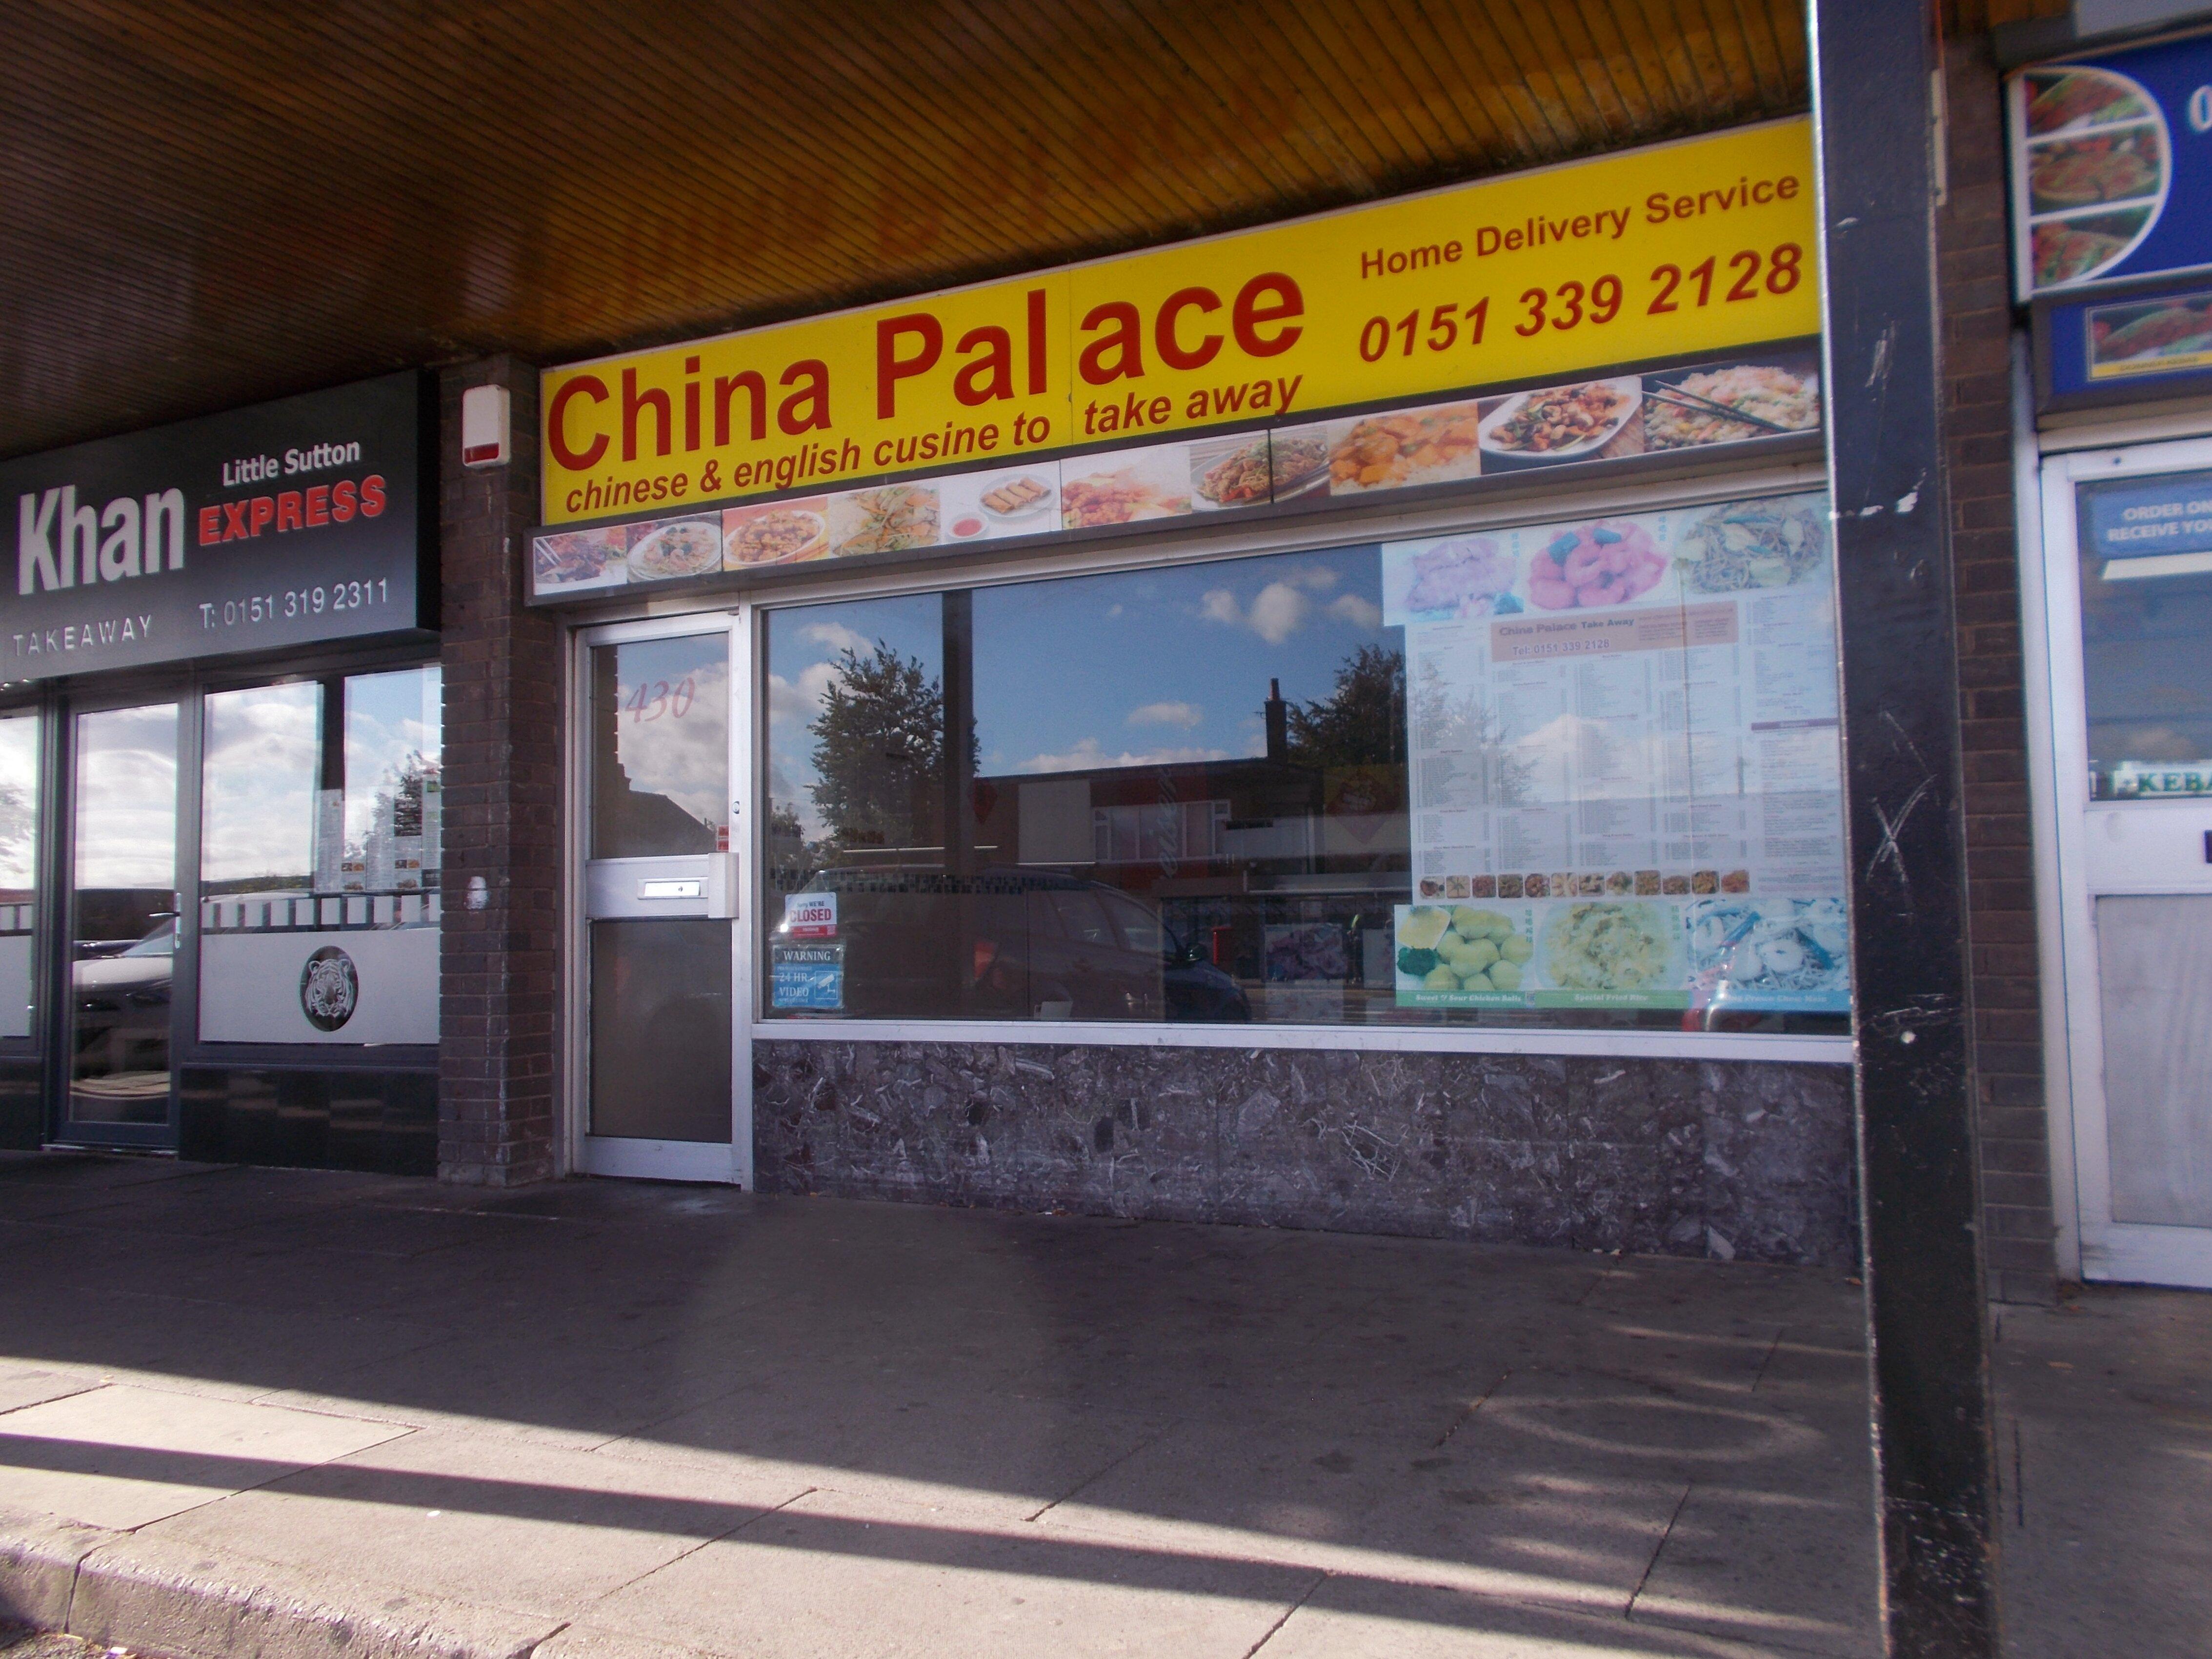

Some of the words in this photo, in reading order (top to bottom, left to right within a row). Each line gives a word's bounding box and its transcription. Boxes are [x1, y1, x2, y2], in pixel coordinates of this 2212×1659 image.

[1361, 241, 1463, 279] Home
[1476, 207, 1631, 257] Delivery
[1646, 176, 1799, 223] Service
[1359, 297, 1490, 363] 0151
[1515, 274, 1624, 337] 339
[1647, 242, 1803, 315] 2128
[547, 355, 833, 471] China
[876, 271, 1305, 420] Palace
[223, 452, 279, 487] Little
[284, 441, 360, 475] Sutton
[566, 472, 689, 513] chinese
[700, 459, 722, 492] &
[733, 438, 860, 489] english
[874, 422, 999, 466] cusine
[1013, 411, 1050, 446] to
[1084, 393, 1171, 435] take
[1186, 374, 1304, 418] away
[199, 475, 387, 546] EXPRESS
[2107, 521, 2180, 542] RECEIVE
[2123, 502, 2184, 521] ORDER
[18, 484, 185, 595] Khan
[200, 603, 216, 629] T:
[224, 596, 273, 627] 0151
[284, 587, 324, 618] 319
[333, 578, 388, 610] 2311
[13, 615, 152, 657] TAKEAWAY
[1500, 626, 1534, 636] China
[1537, 623, 1577, 632] Palace
[1581, 621, 1604, 629] Take
[1607, 618, 1634, 627] Away
[1513, 646, 1530, 655] Tel:
[1534, 643, 1558, 654] 0151
[1562, 641, 1581, 652] 339
[1585, 639, 1610, 650] 2128
[625, 677, 695, 723] 430
[790, 908, 832, 923] CLOSED
[780, 972, 790, 982] 24
[783, 951, 831, 961] WARNING
[779, 987, 809, 997] VIDEO
